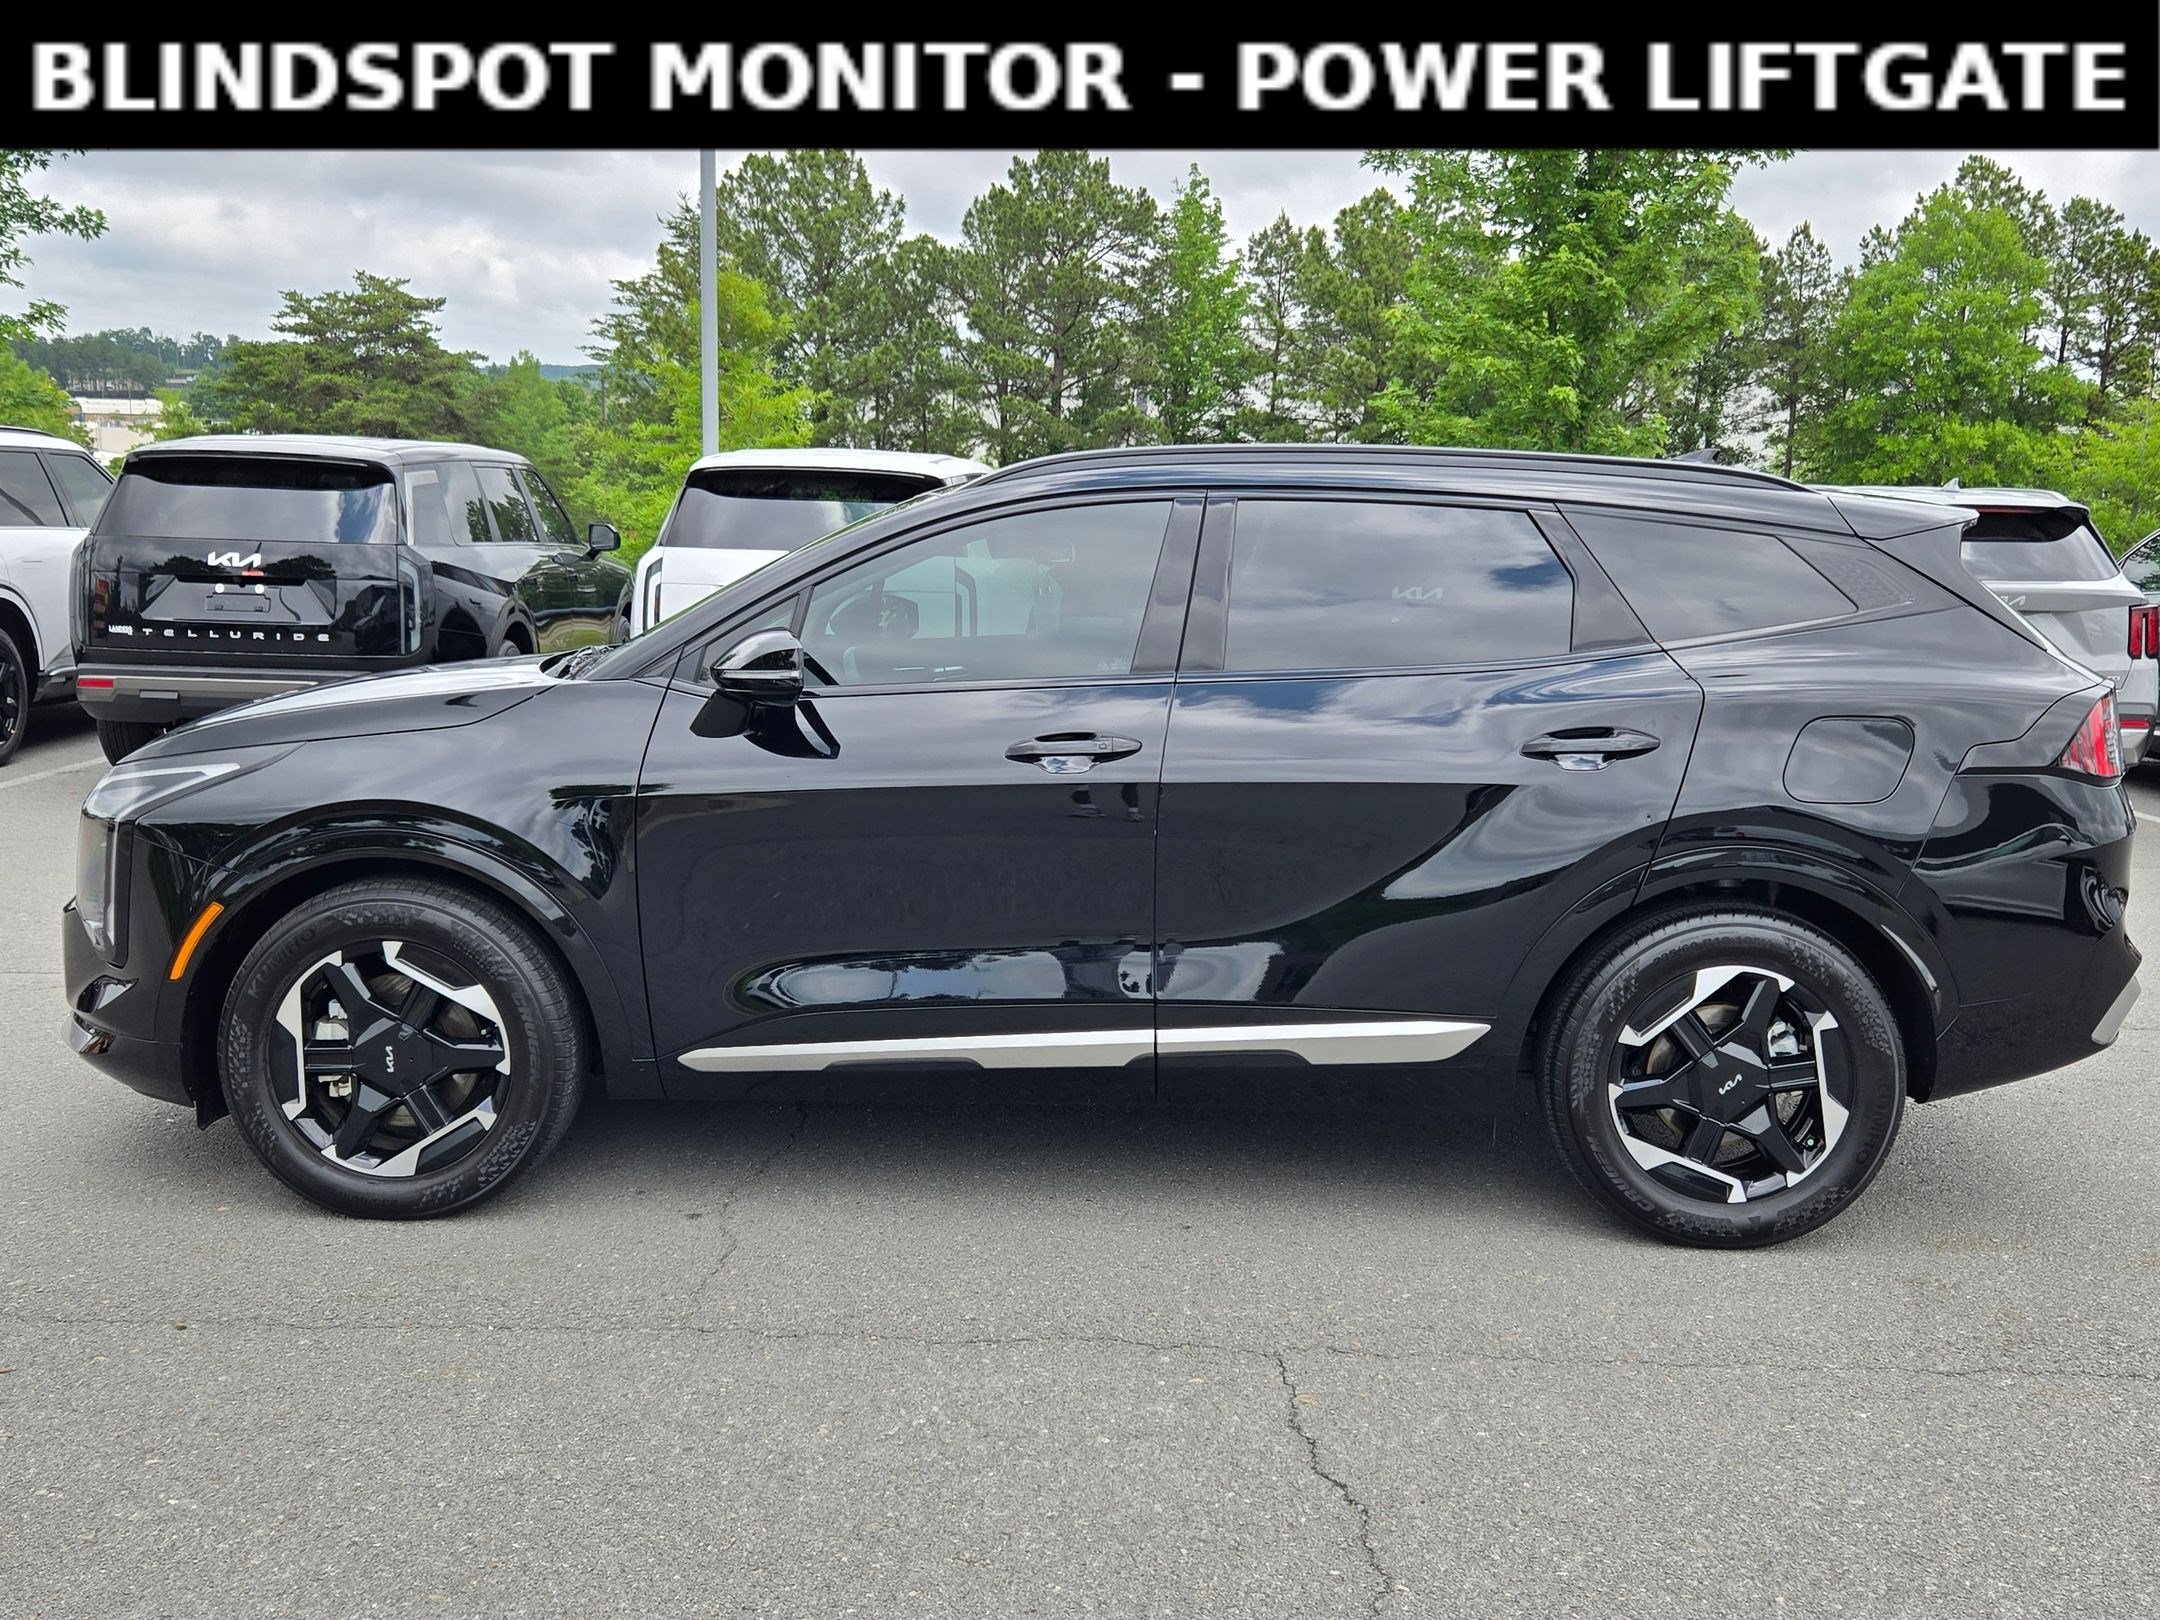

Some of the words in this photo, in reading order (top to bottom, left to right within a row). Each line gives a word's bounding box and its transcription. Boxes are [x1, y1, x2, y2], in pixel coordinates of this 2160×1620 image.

[207, 551, 262, 568] KIA
[1391, 586, 1443, 600] KIA
[142, 627, 330, 642] TELLURIDE
[385, 1045, 394, 1073] KIA
[1718, 1073, 1743, 1095] KIA
